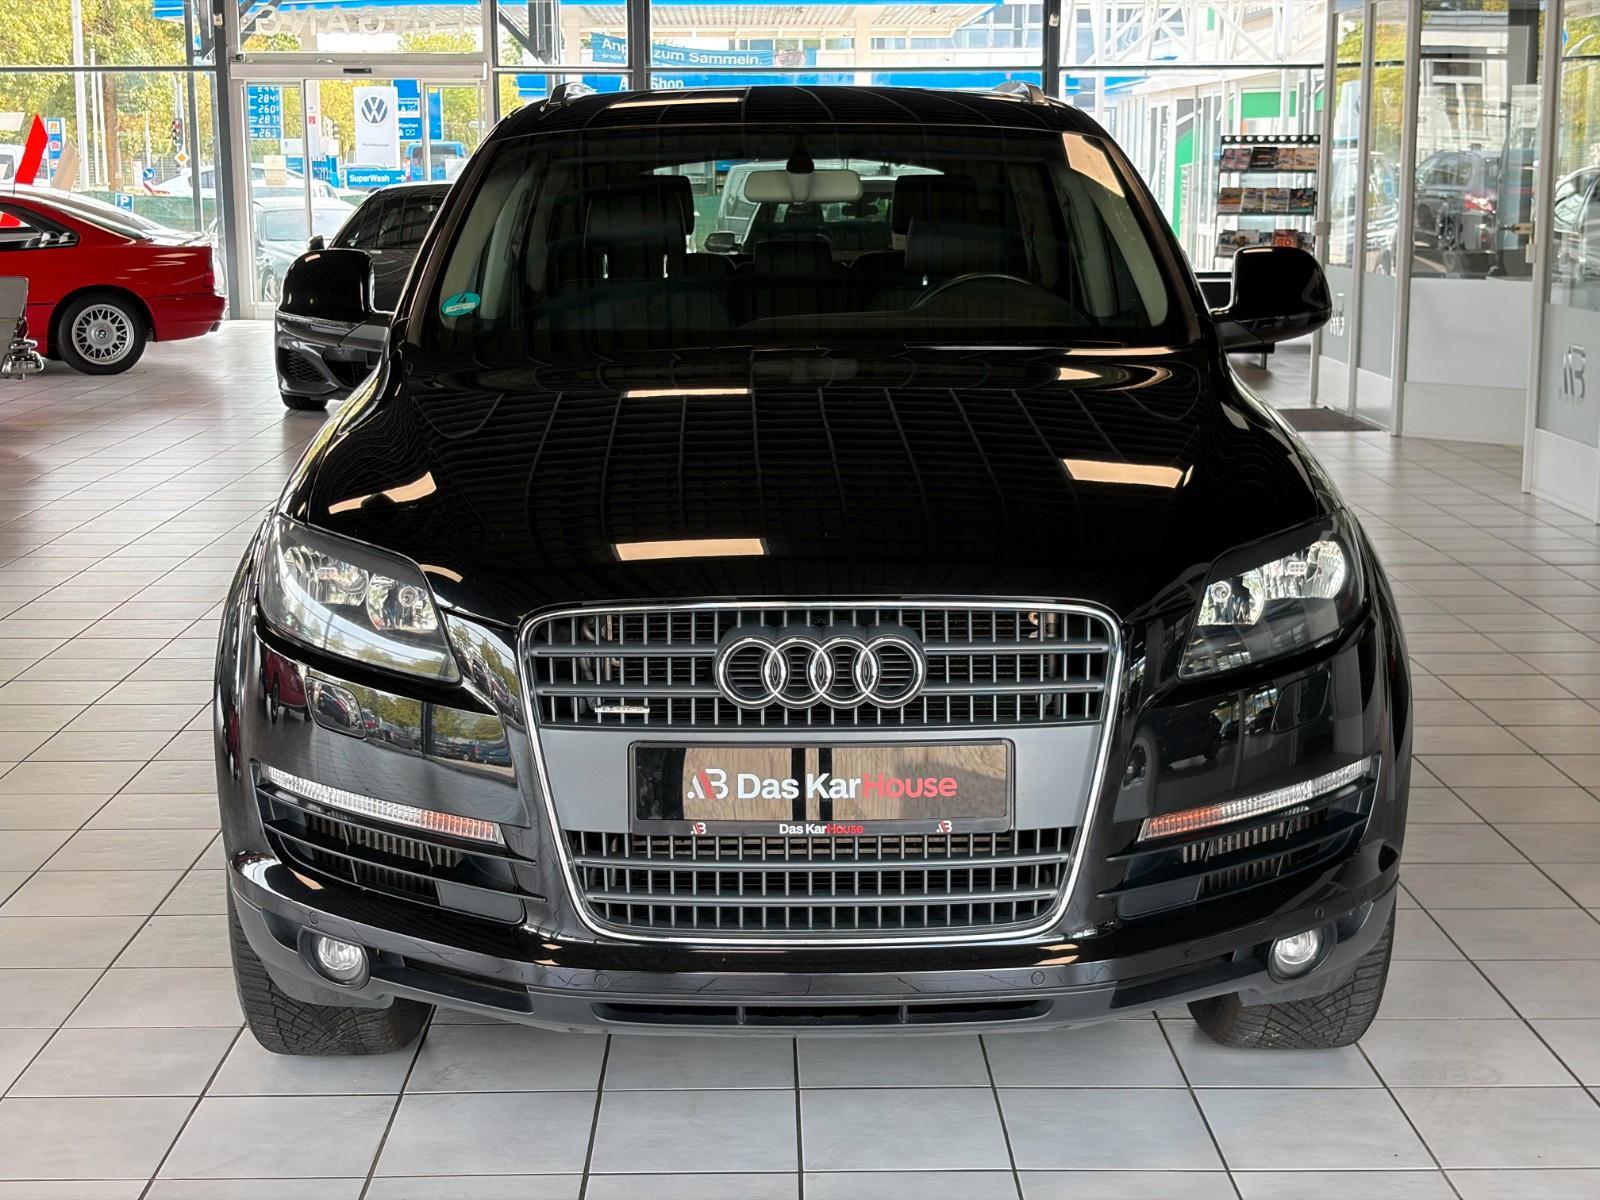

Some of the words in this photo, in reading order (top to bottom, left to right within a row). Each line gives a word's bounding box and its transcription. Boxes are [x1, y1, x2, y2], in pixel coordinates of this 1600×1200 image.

[653, 51, 685, 61] zum
[689, 52, 763, 65] Sammeln.
[651, 77, 684, 88] Shop
[349, 174, 390, 183] SuperWash
[120, 195, 129, 206] P
[737, 774, 800, 799] Das
[806, 773, 958, 798] KarHouse
[779, 823, 803, 834] Das
[805, 823, 864, 834] KarHouse
